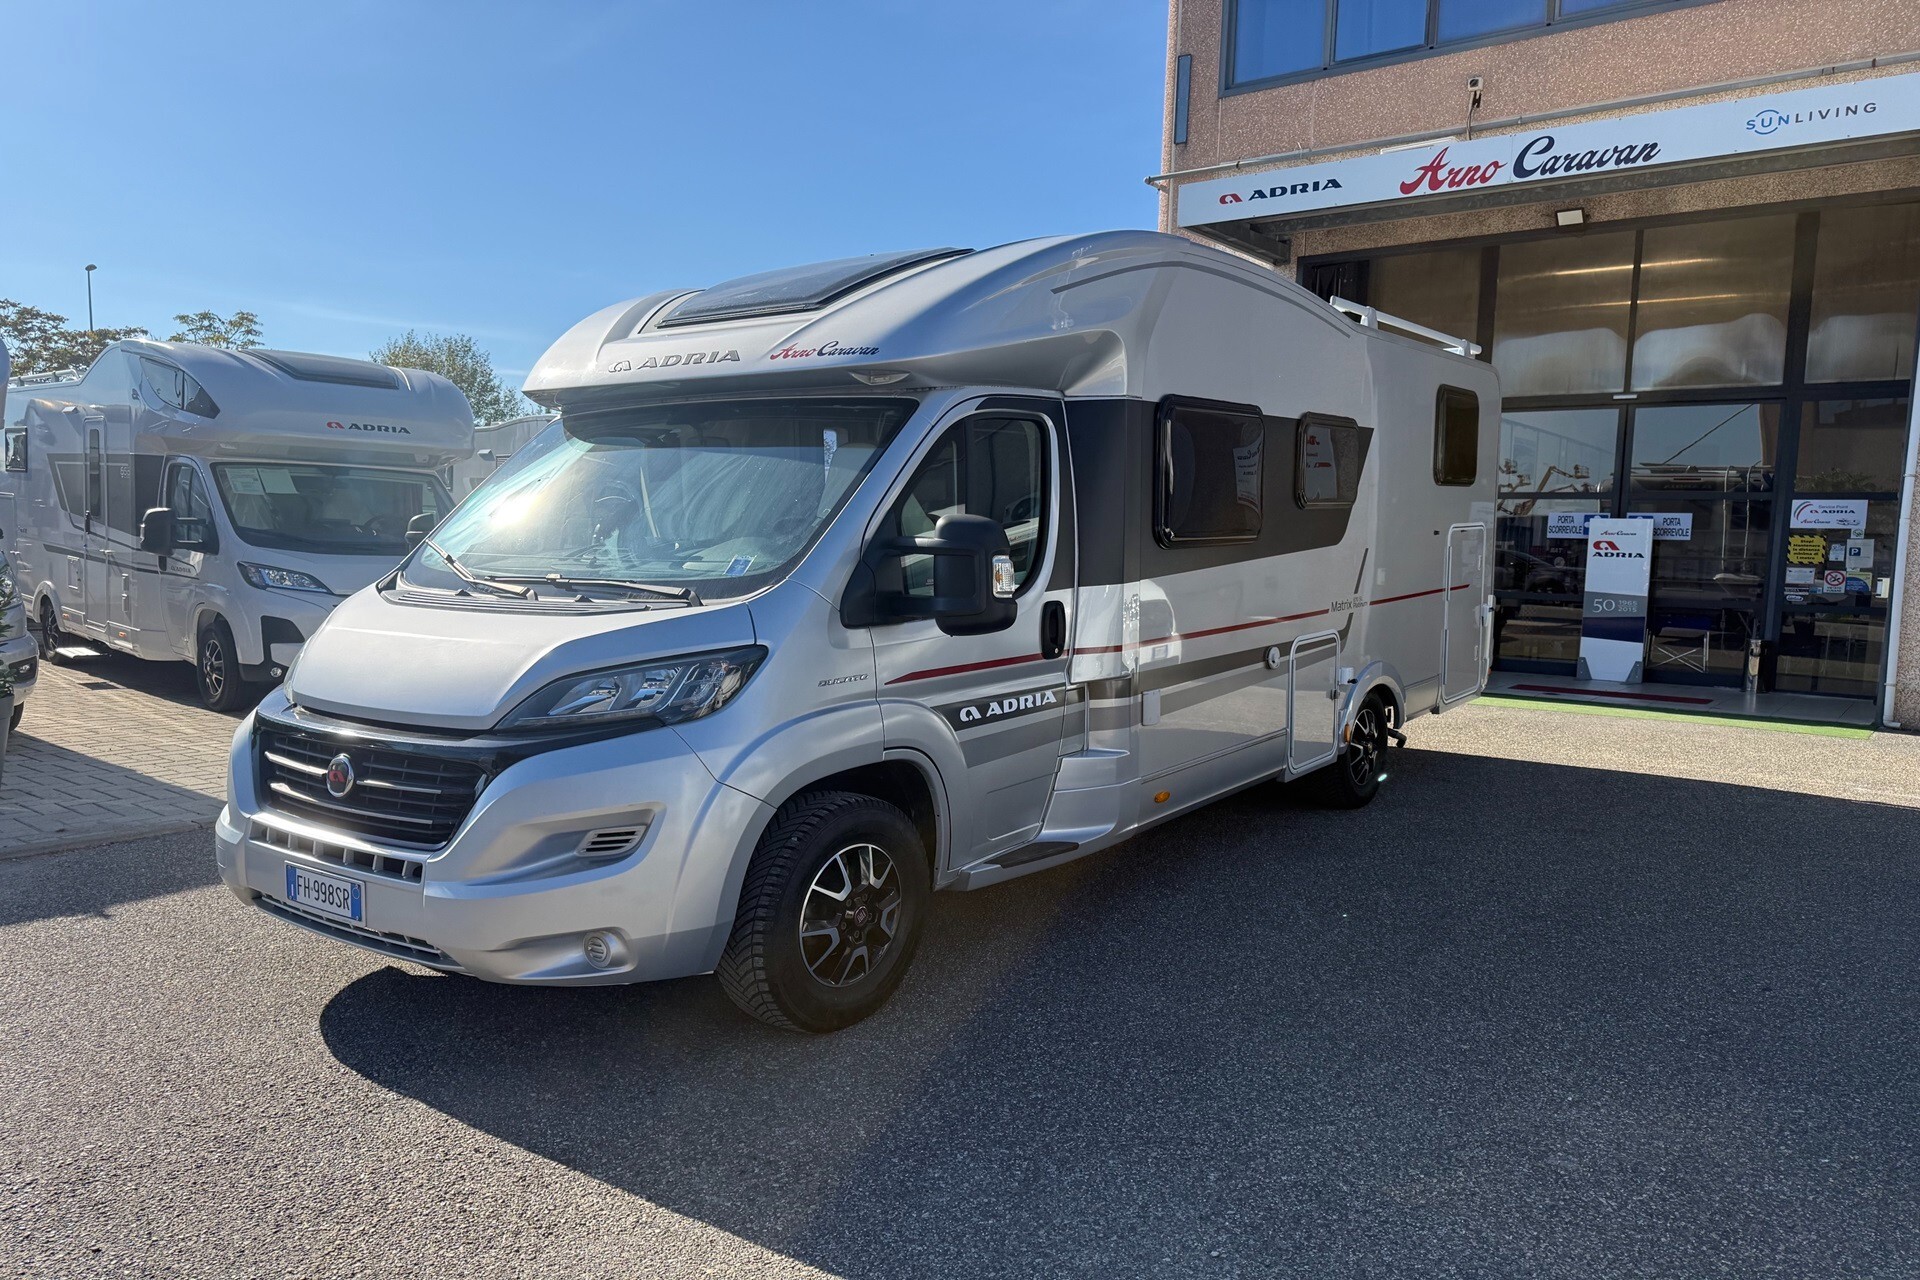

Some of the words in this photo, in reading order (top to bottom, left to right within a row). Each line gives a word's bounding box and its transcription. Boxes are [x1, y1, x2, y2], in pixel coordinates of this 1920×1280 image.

[1746, 102, 1877, 130] SUNLIVING
[1400, 146, 1508, 195] Arno
[1512, 135, 1661, 179] Caravan
[1248, 178, 1342, 201] ADRIA
[769, 343, 816, 361] Arno
[817, 340, 880, 357] Caravan
[637, 349, 741, 370] ADRIA
[348, 422, 411, 435] ADRIA
[1557, 515, 1574, 523] PORTA
[1662, 517, 1681, 526] PORTA
[1548, 525, 1582, 534] SCORREVOLE
[1653, 527, 1690, 537] SCORREVOLE
[1592, 551, 1645, 559] ADRIA
[1331, 599, 1352, 612] Matrix
[1592, 598, 1615, 613] 50
[985, 690, 1057, 717] ADRIA
